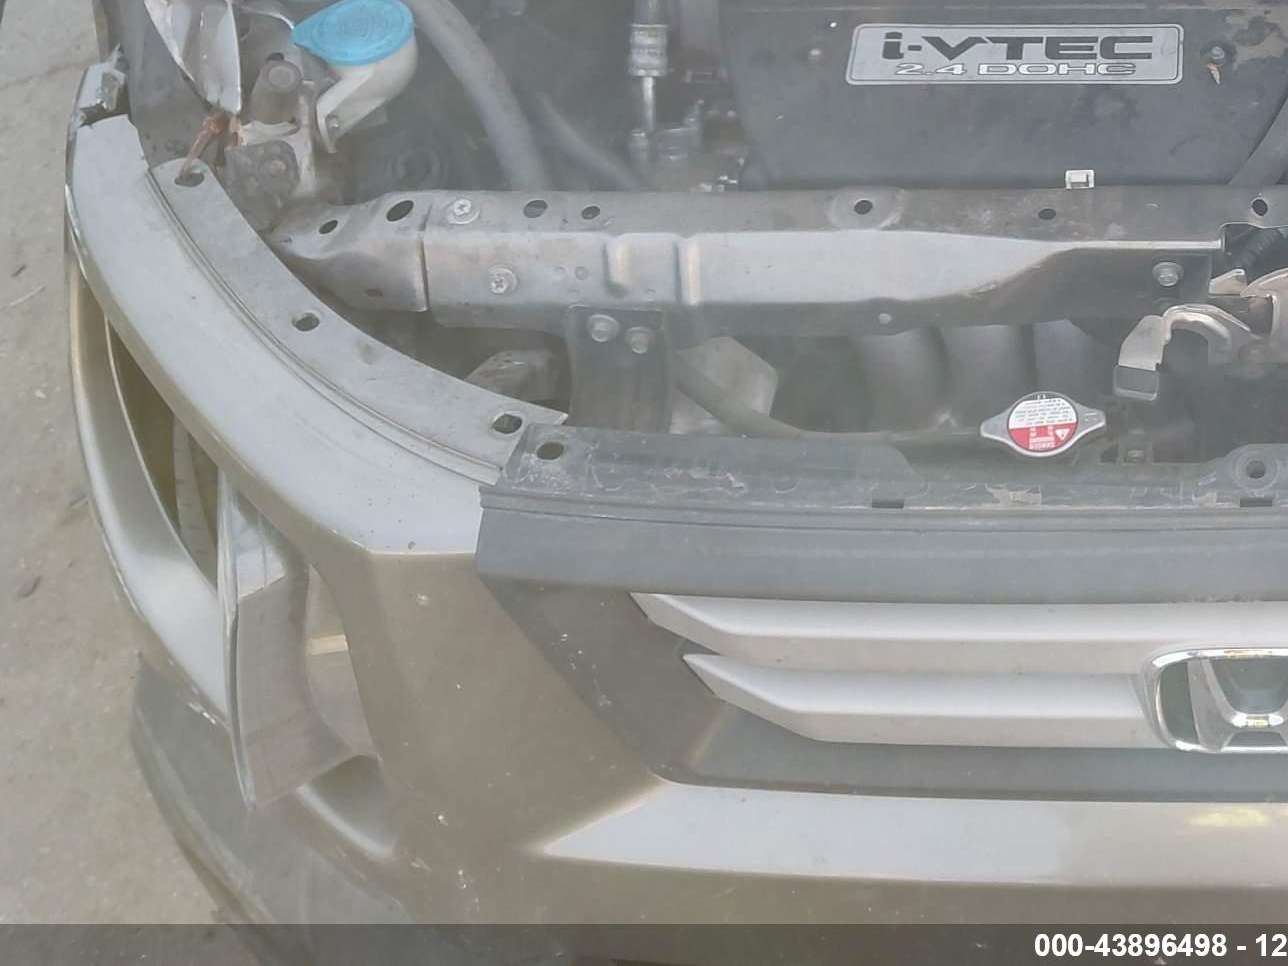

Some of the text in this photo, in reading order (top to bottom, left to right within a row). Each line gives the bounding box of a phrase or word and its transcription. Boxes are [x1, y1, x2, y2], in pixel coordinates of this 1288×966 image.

[882, 31, 1153, 61] i-VTEC
[895, 62, 1137, 76] 2.4 DOHC
